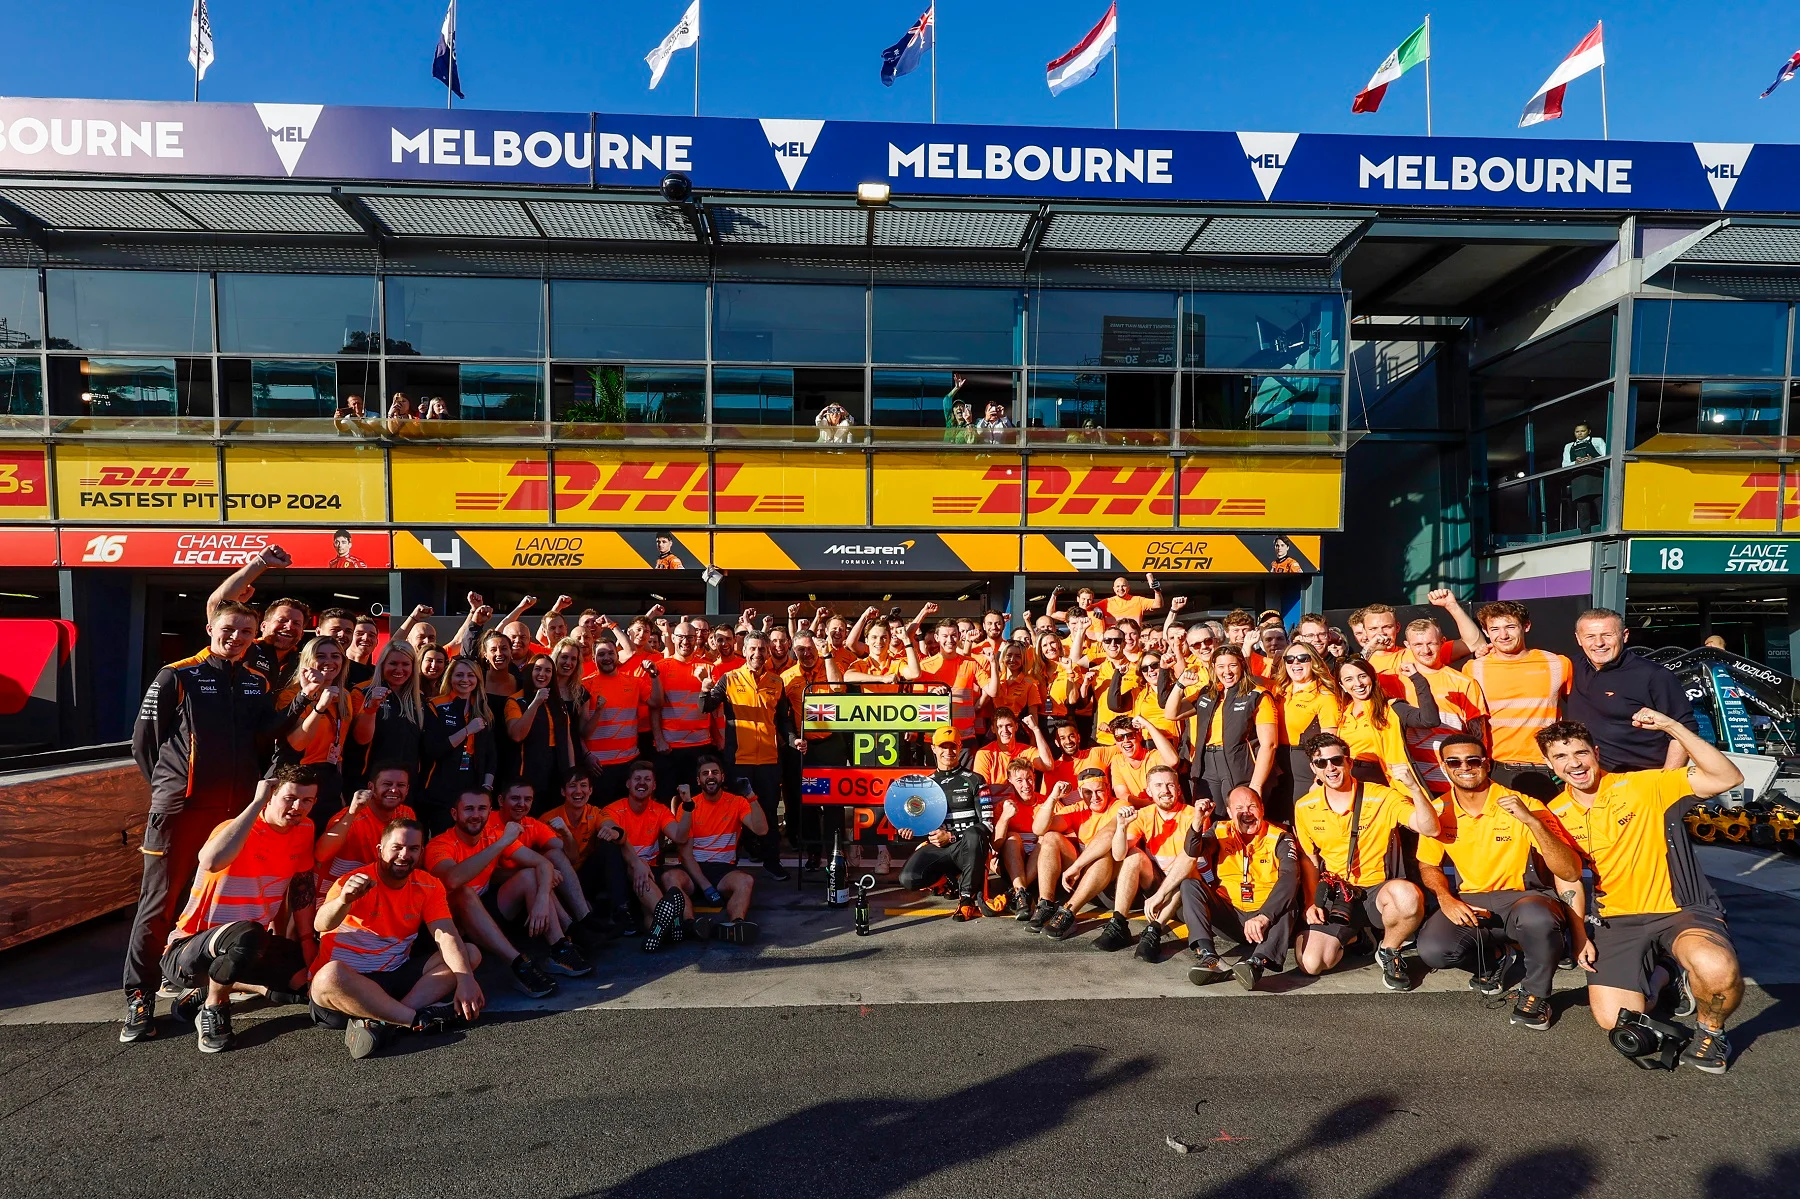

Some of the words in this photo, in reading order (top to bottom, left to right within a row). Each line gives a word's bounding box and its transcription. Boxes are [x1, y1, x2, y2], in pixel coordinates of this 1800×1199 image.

[0, 116, 184, 158] OURNE
[267, 126, 309, 143] MEL
[391, 127, 693, 171] MELBOURNE
[771, 140, 810, 158] MEL
[888, 142, 1173, 184] MELBOURNE
[1248, 153, 1286, 169] MEL
[1359, 154, 1633, 194] MELBOURNE
[1703, 162, 1741, 180] MEL
[98, 467, 196, 486] DHL
[502, 460, 745, 513] DHL
[977, 465, 1223, 515] DHL
[80, 492, 177, 507] FASTEST
[183, 493, 218, 508] PIT
[225, 493, 282, 509] STOP
[287, 494, 342, 509] 2024
[82, 535, 128, 563] 16
[177, 534, 269, 549] CHARLES
[515, 537, 583, 551] LANDO
[823, 544, 906, 555] McLaren
[1146, 541, 1208, 555] OSCAR
[511, 553, 585, 566] NORRIS
[1659, 547, 1685, 571] 18
[1729, 544, 1789, 558] LANCE
[1141, 556, 1213, 570] PIASTRI
[1724, 559, 1790, 572] STROLL
[1732, 660, 1782, 685] cognizant
[835, 704, 918, 722] LANDO
[854, 733, 898, 766] P3
[853, 808, 897, 841] P4
